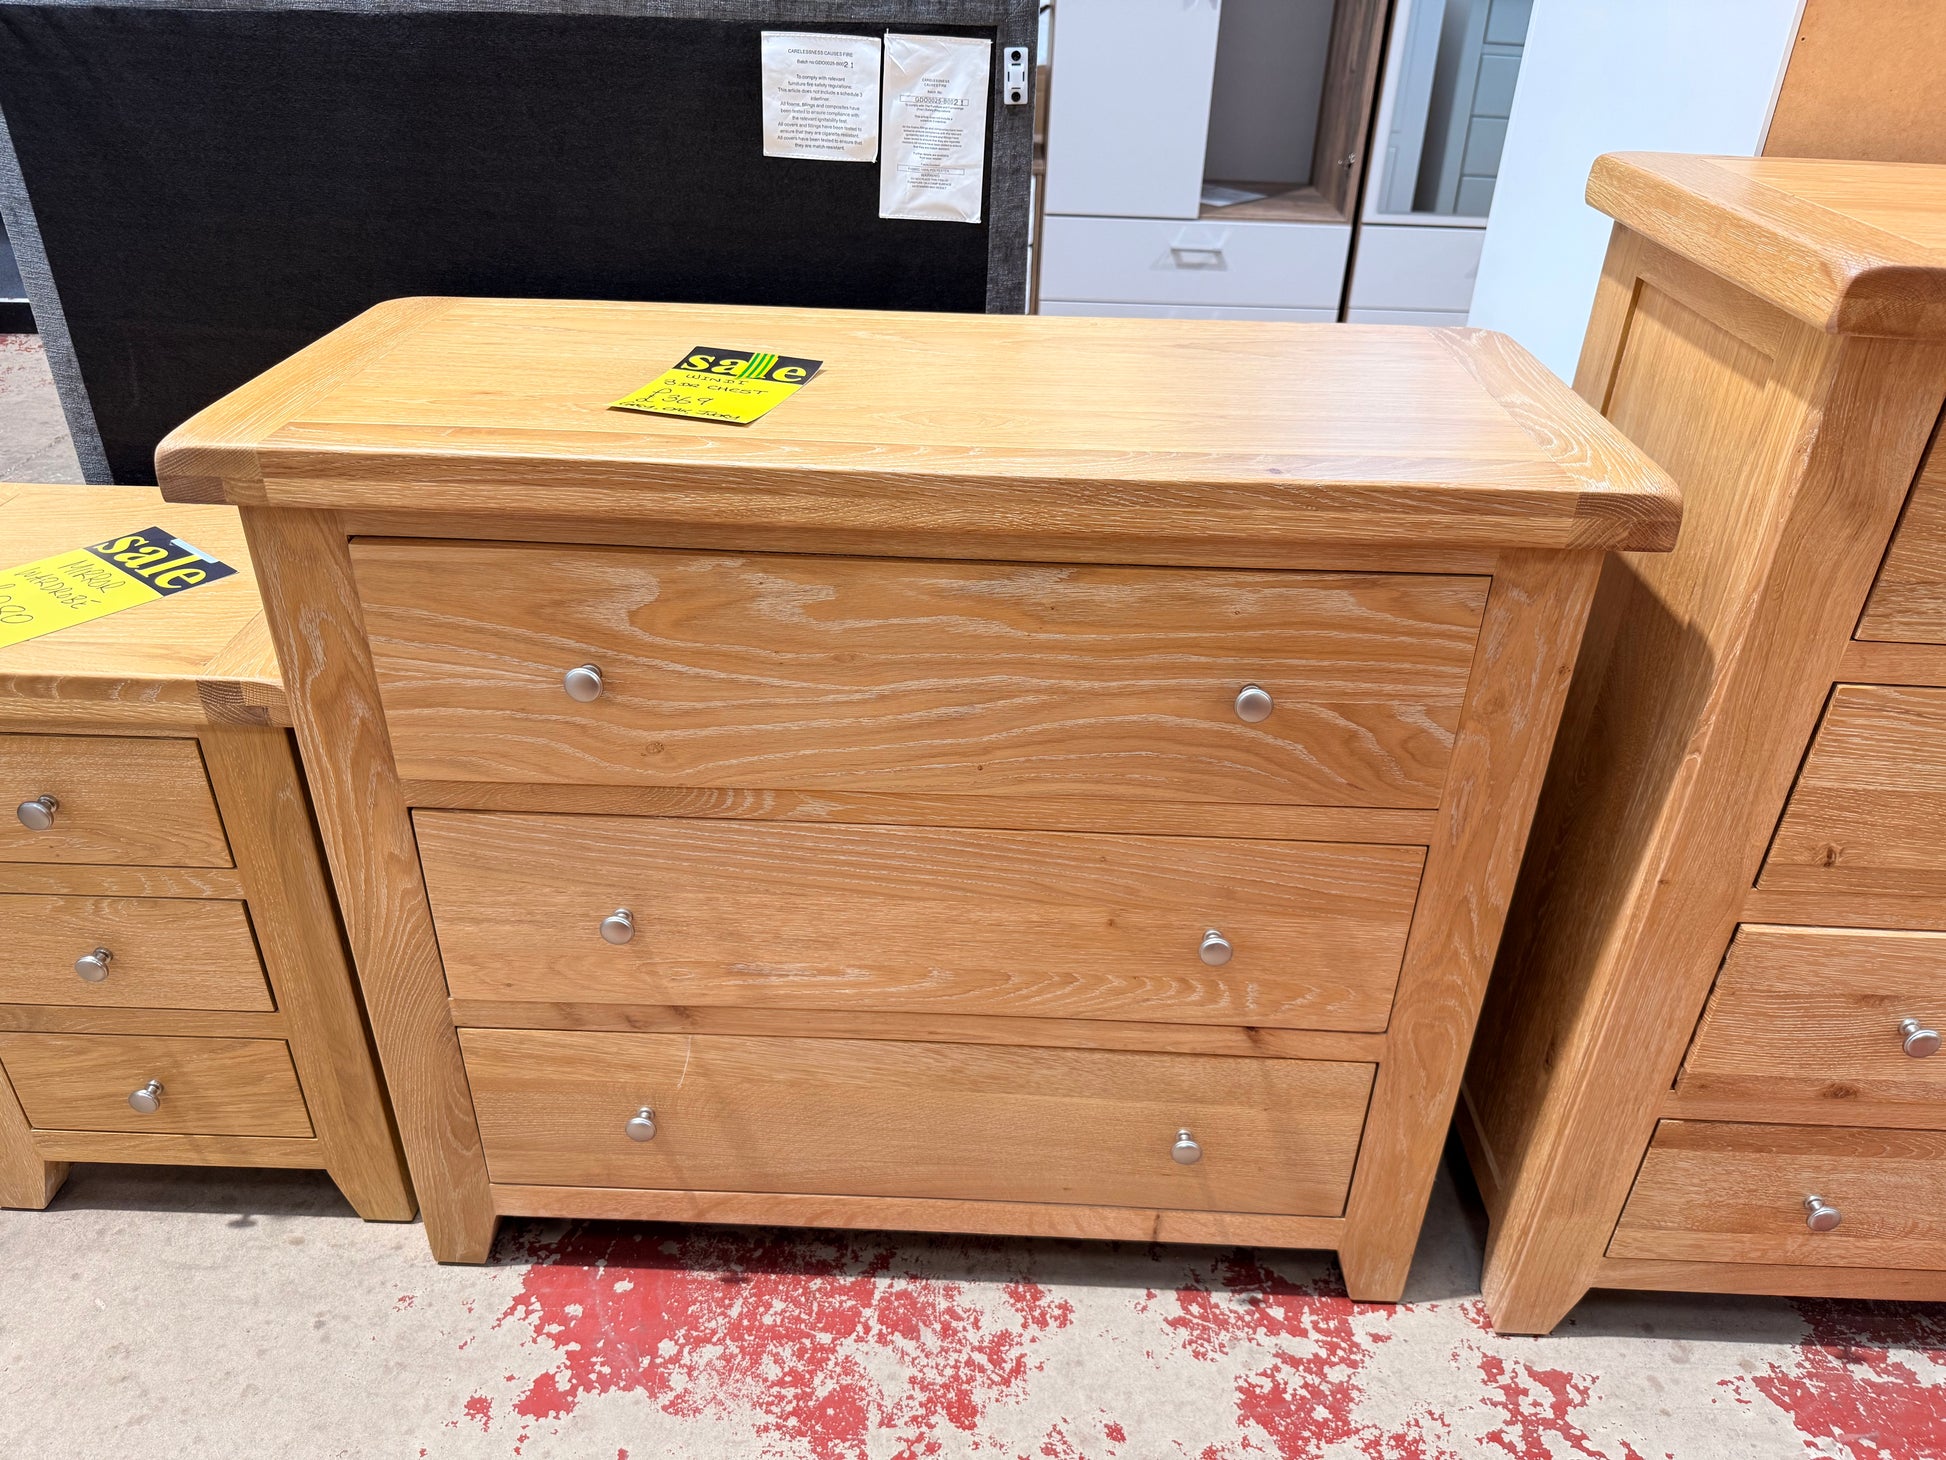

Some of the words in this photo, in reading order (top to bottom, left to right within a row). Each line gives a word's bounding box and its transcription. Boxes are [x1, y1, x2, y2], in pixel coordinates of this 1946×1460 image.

[681, 353, 807, 382] sale
[707, 385, 769, 394] CHEST
[93, 536, 207, 589] sale
